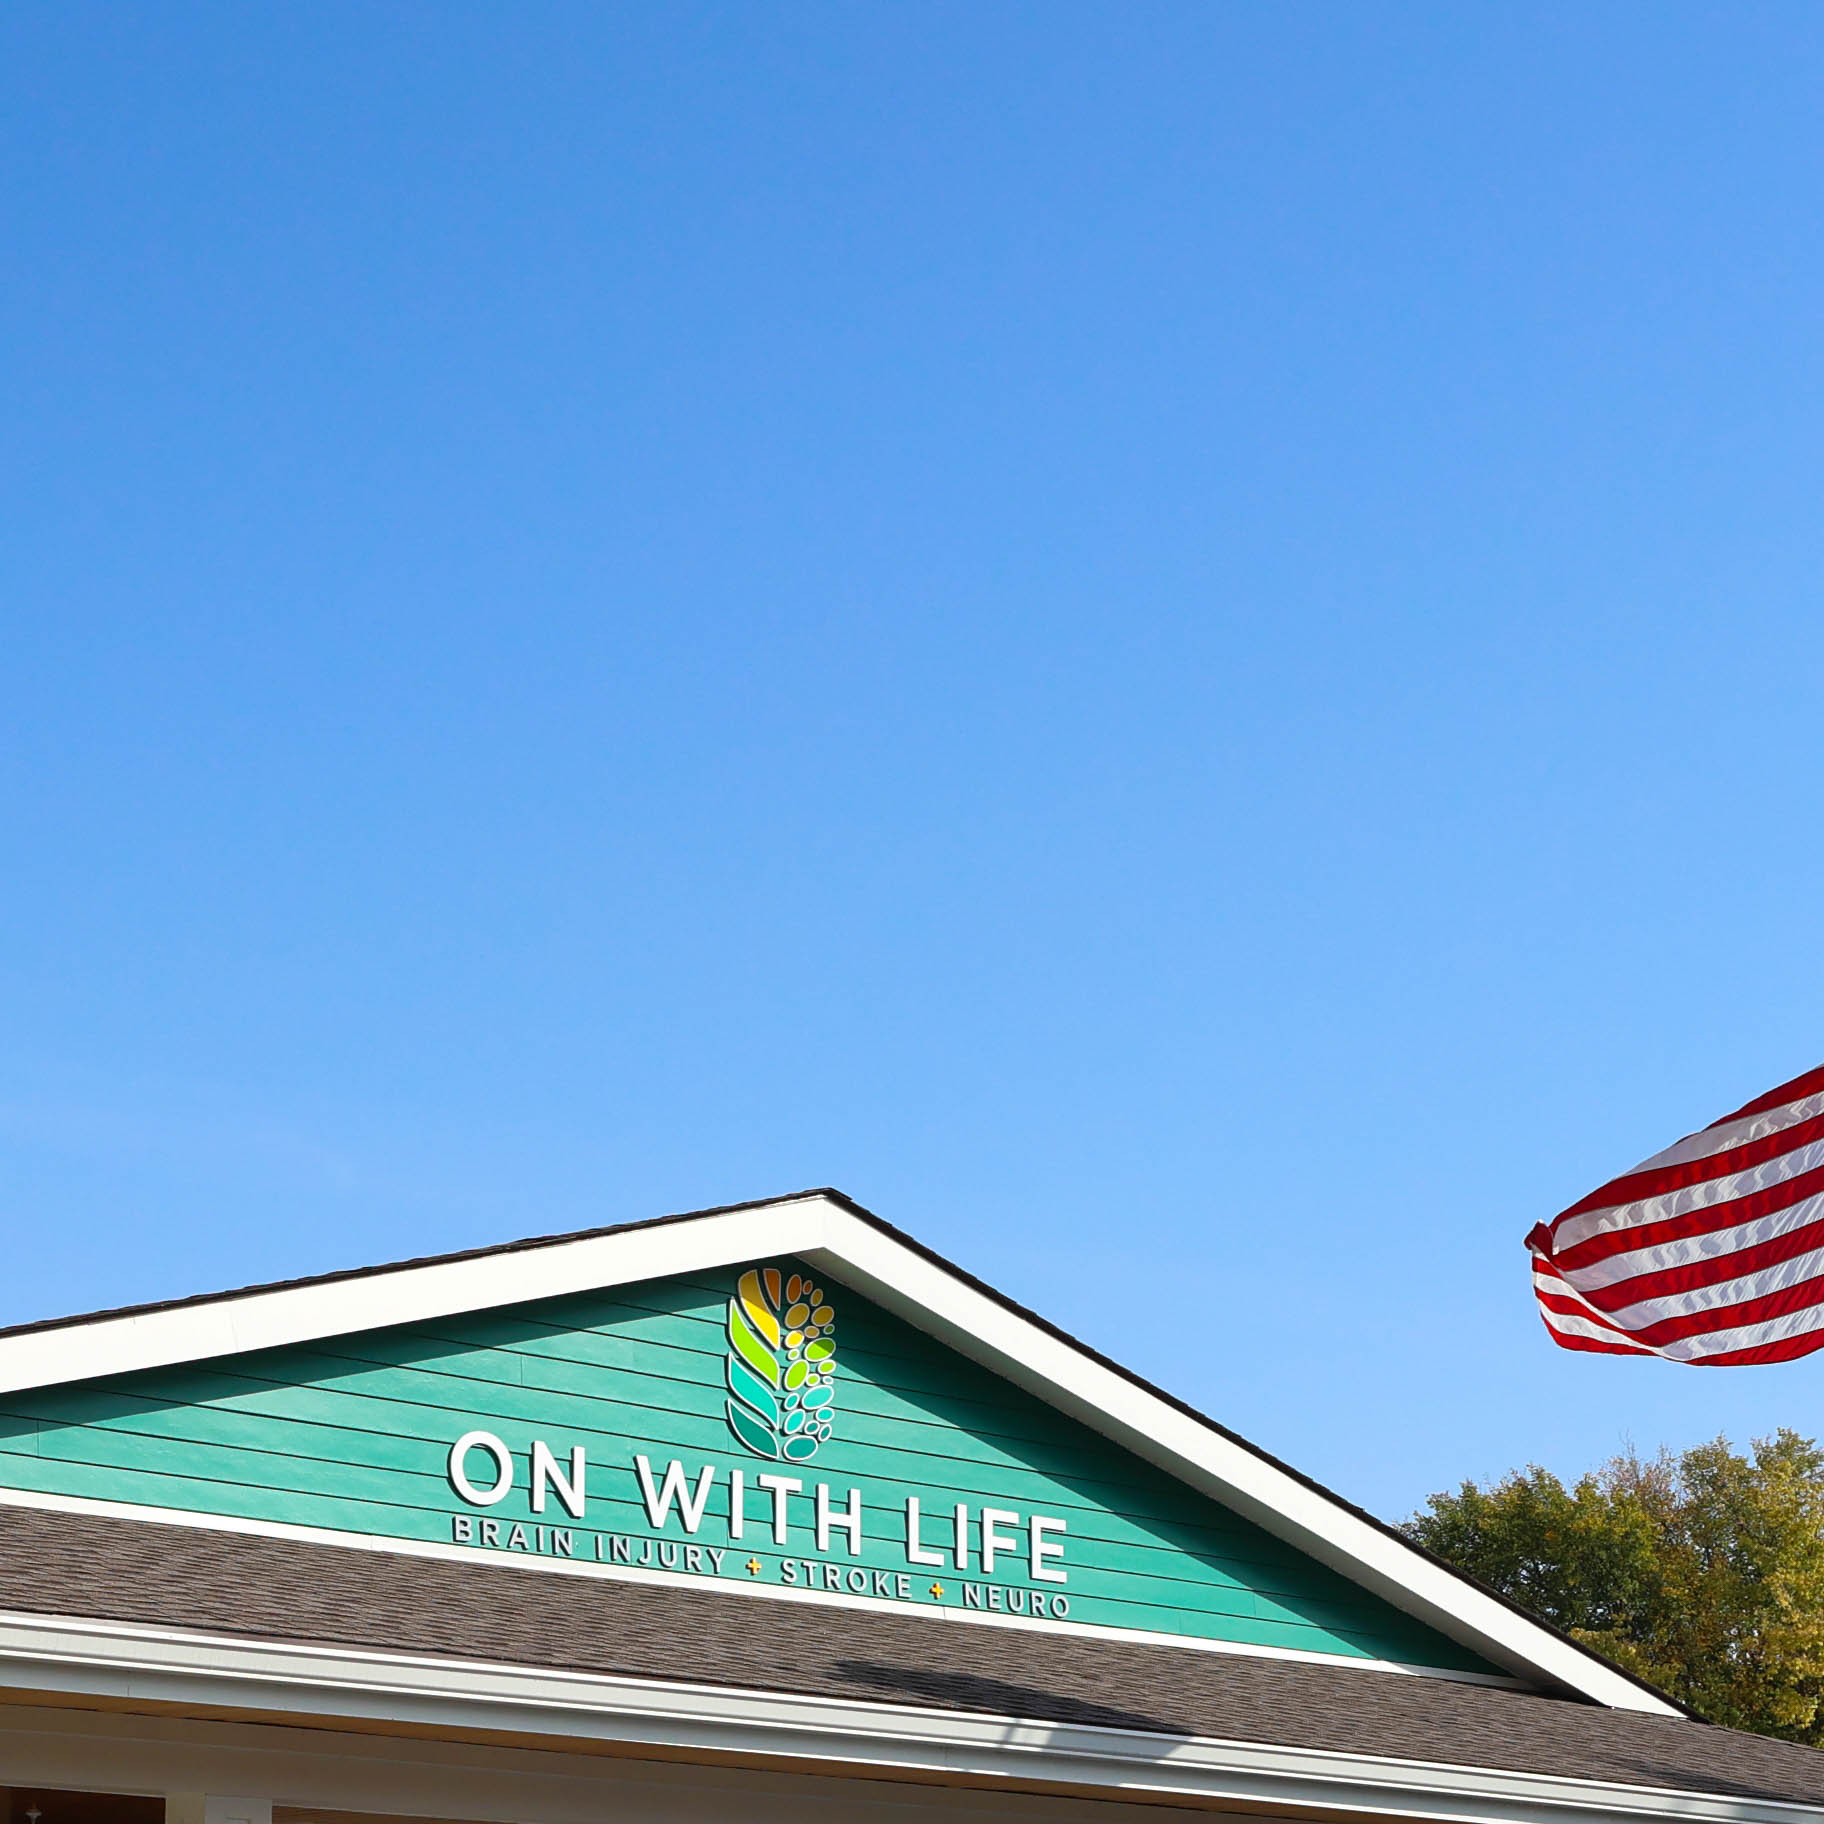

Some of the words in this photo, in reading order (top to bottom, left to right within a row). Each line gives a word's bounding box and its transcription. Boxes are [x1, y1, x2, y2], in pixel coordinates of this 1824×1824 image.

[448, 1430, 586, 1518] ON
[635, 1454, 863, 1556] WITH
[905, 1495, 1068, 1584] LIFE
[452, 1517, 574, 1556] BRAIN
[594, 1534, 726, 1575] INJURY
[780, 1558, 914, 1600] STROKE
[961, 1582, 1071, 1619] NEURO
